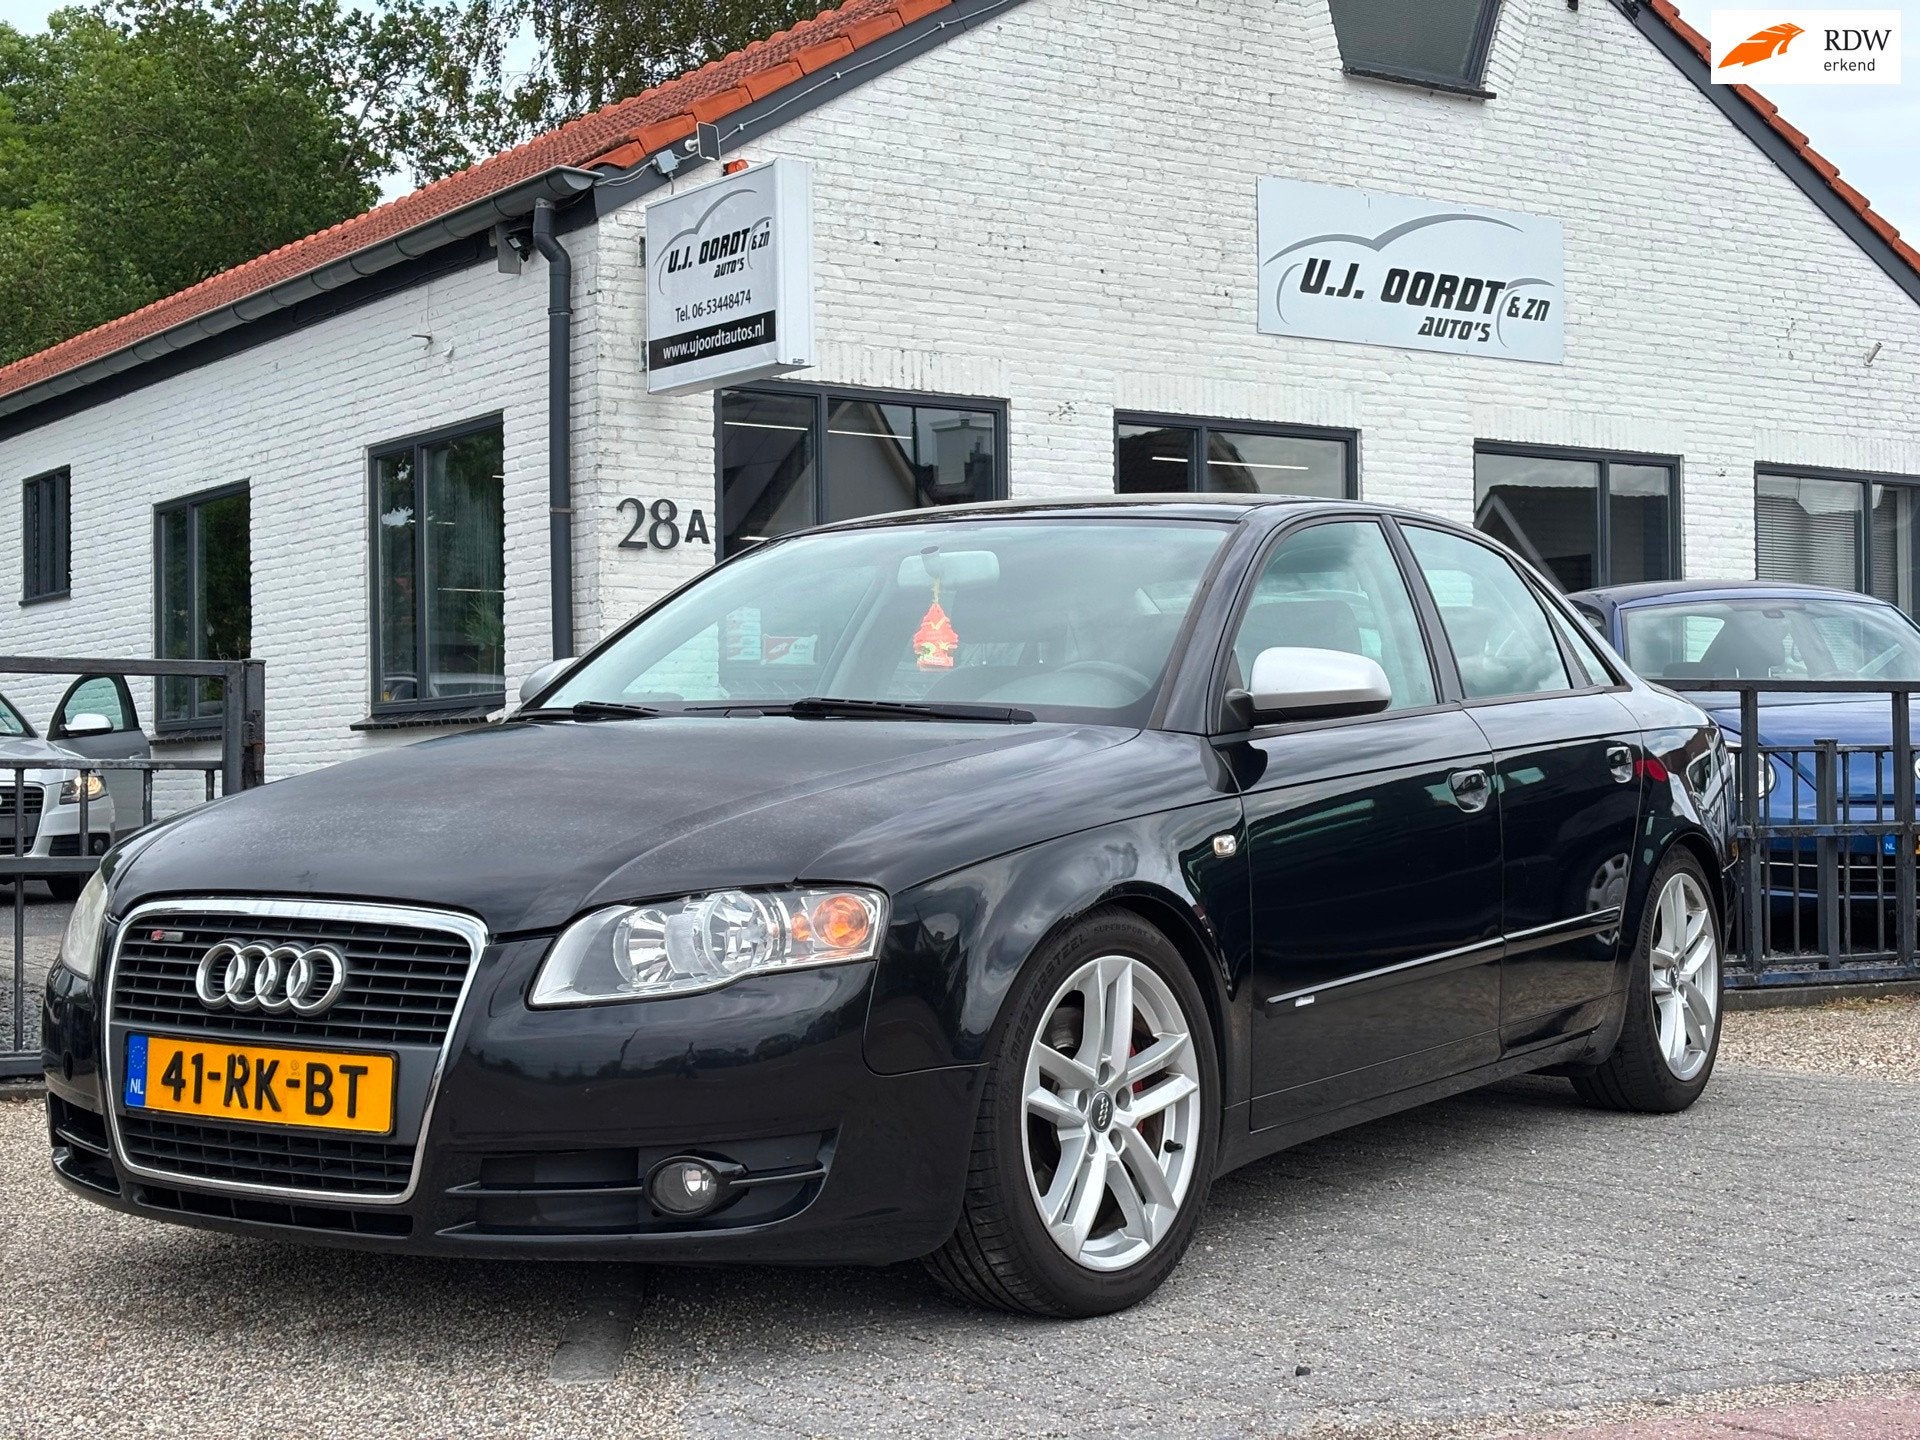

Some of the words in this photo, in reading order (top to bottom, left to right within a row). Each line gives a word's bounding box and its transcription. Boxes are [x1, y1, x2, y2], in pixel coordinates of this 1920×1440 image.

[667, 245, 693, 274] U.J.
[698, 227, 751, 265] OORDT
[675, 306, 691, 323] Tel.
[692, 288, 752, 319] 06-53448474
[1299, 257, 1365, 300] U.J.
[1380, 267, 1507, 315] OORDT
[662, 318, 765, 360] www.ujoordtautos.nl
[1417, 315, 1492, 343] AUTO'S
[1885, 842, 1896, 850] NL
[129, 1077, 144, 1095] NL
[160, 1050, 369, 1119] 41-RK-BT
